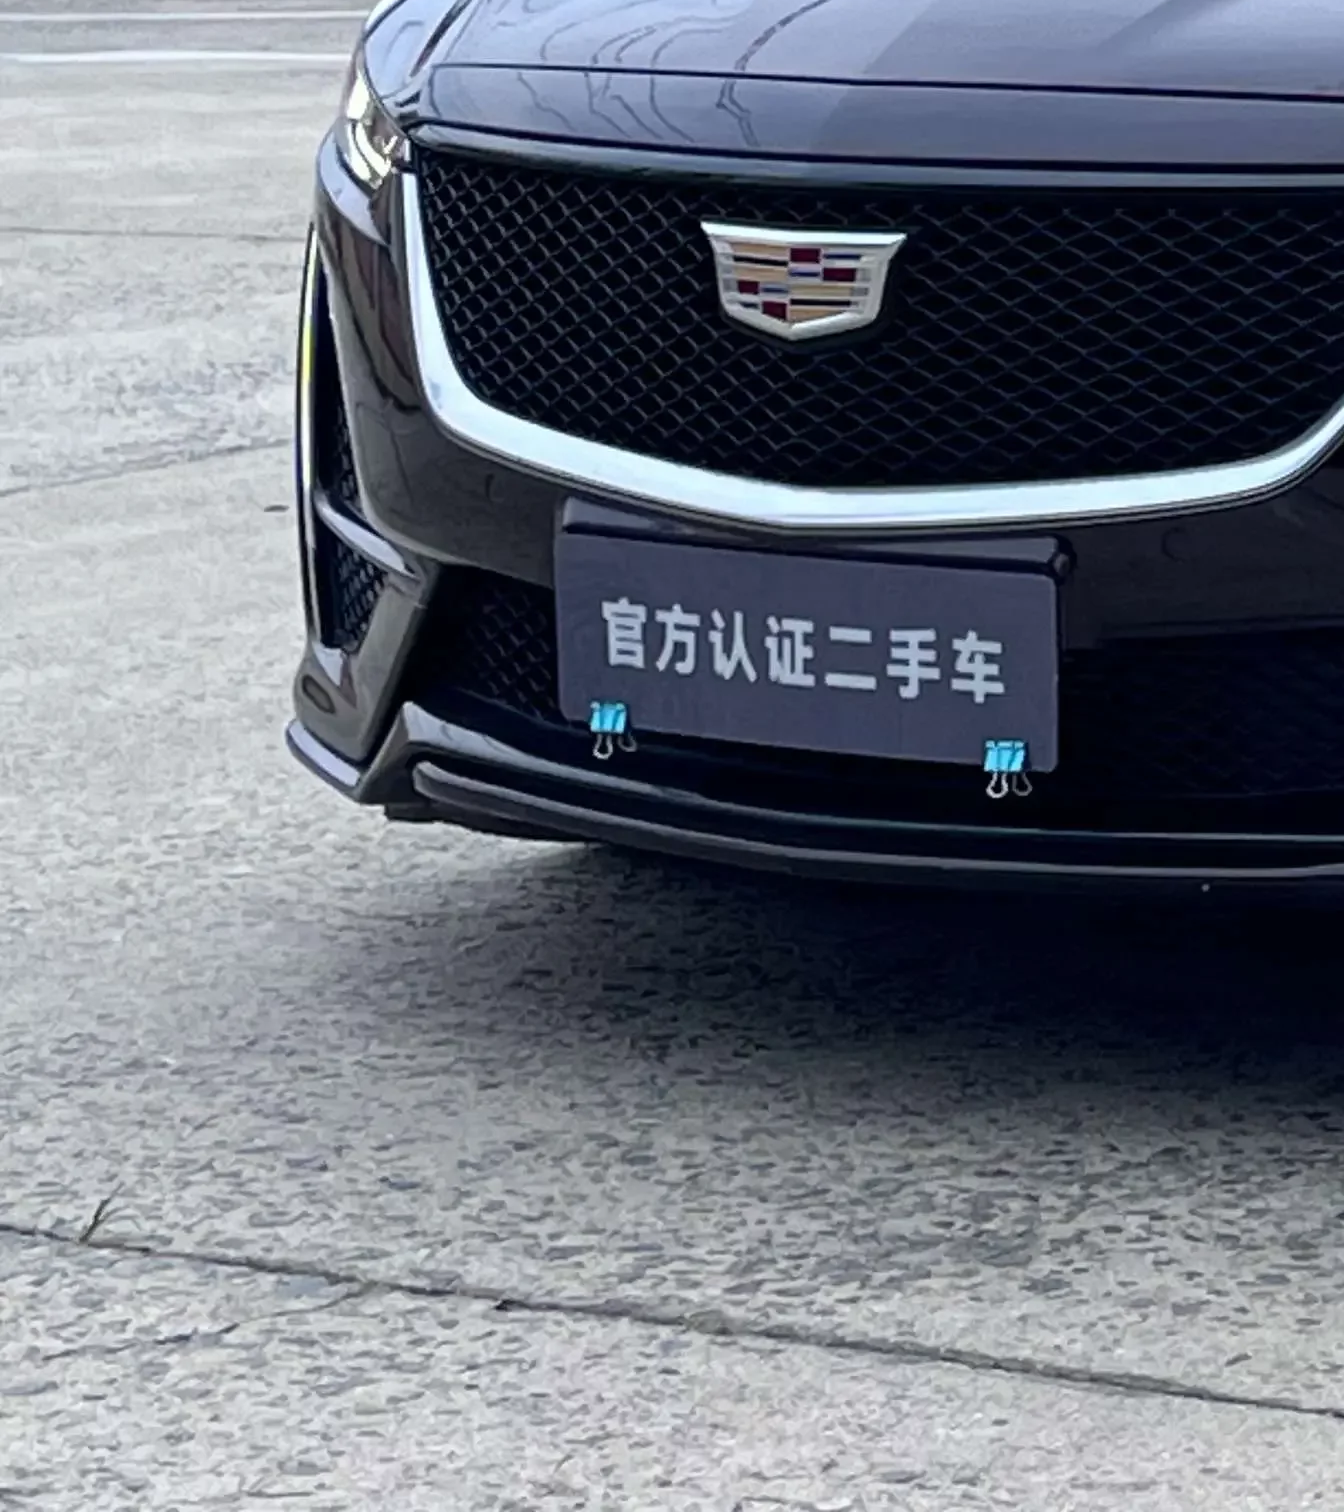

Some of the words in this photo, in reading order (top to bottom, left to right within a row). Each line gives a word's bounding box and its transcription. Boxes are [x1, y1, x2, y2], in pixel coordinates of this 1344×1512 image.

[601, 597, 1005, 703] 官方认证二手车
